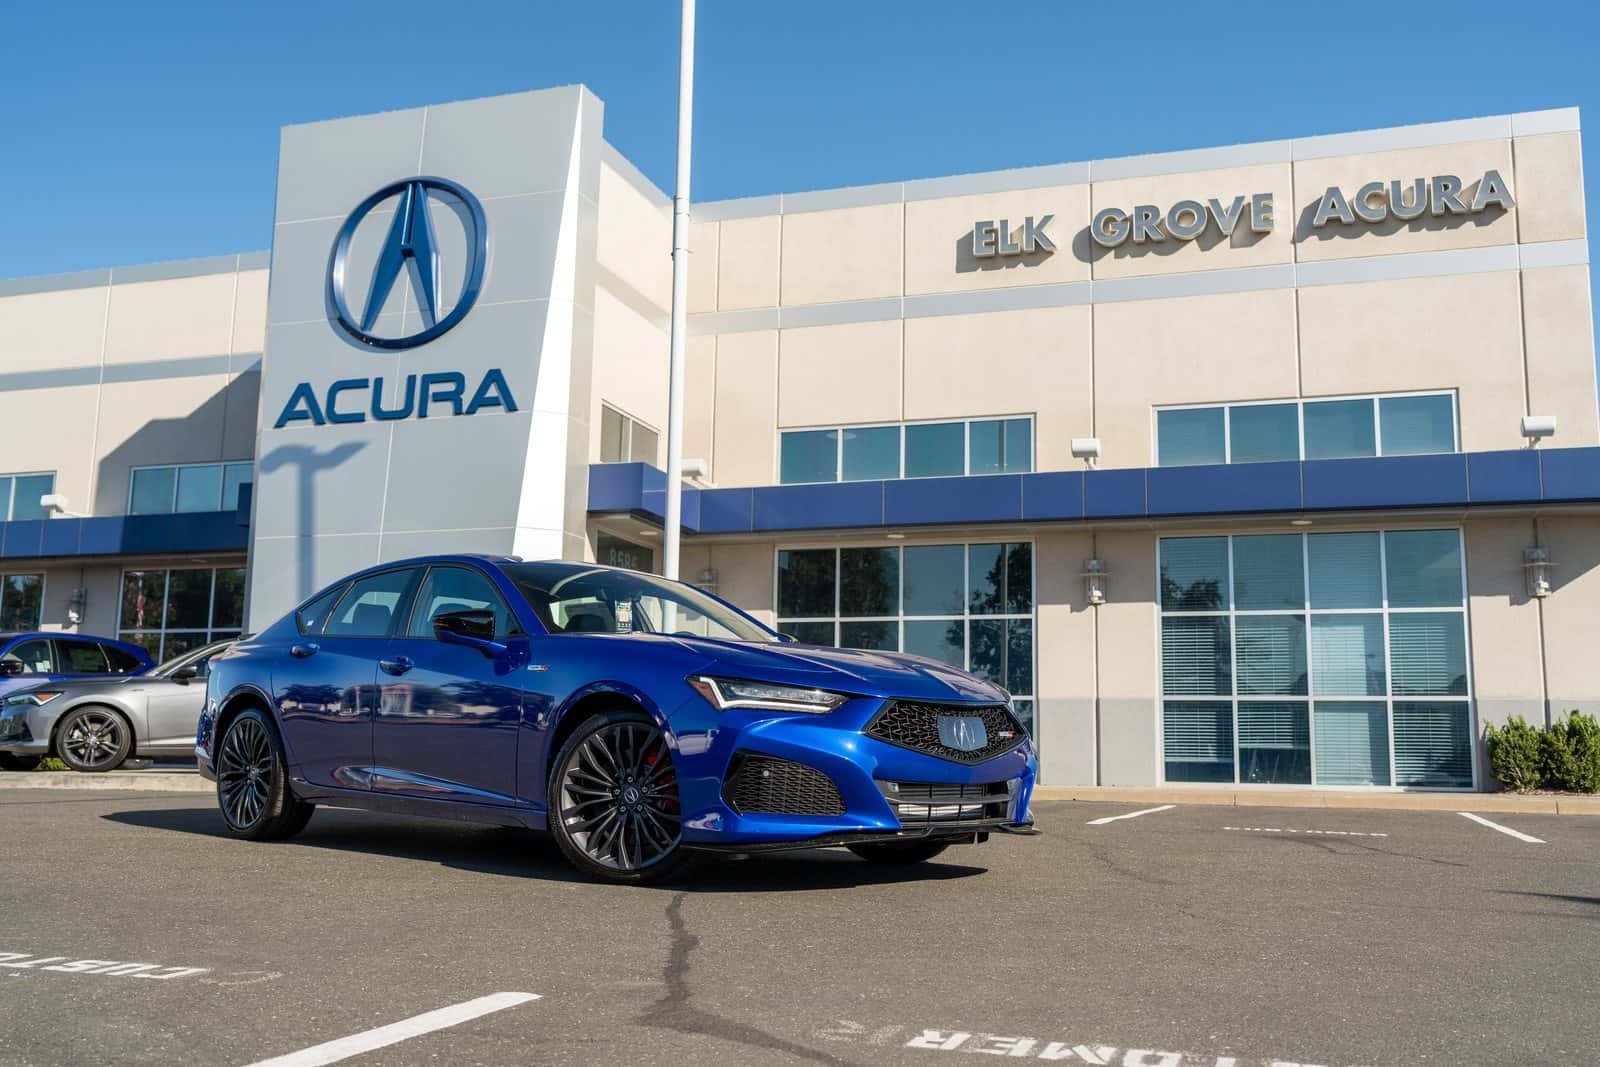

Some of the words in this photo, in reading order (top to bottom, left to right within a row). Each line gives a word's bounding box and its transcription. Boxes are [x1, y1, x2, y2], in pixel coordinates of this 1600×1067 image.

[973, 214, 1056, 257] ELK
[1090, 192, 1274, 248] GROVE
[1313, 169, 1516, 228] ACURA
[274, 368, 518, 429] ACURA
